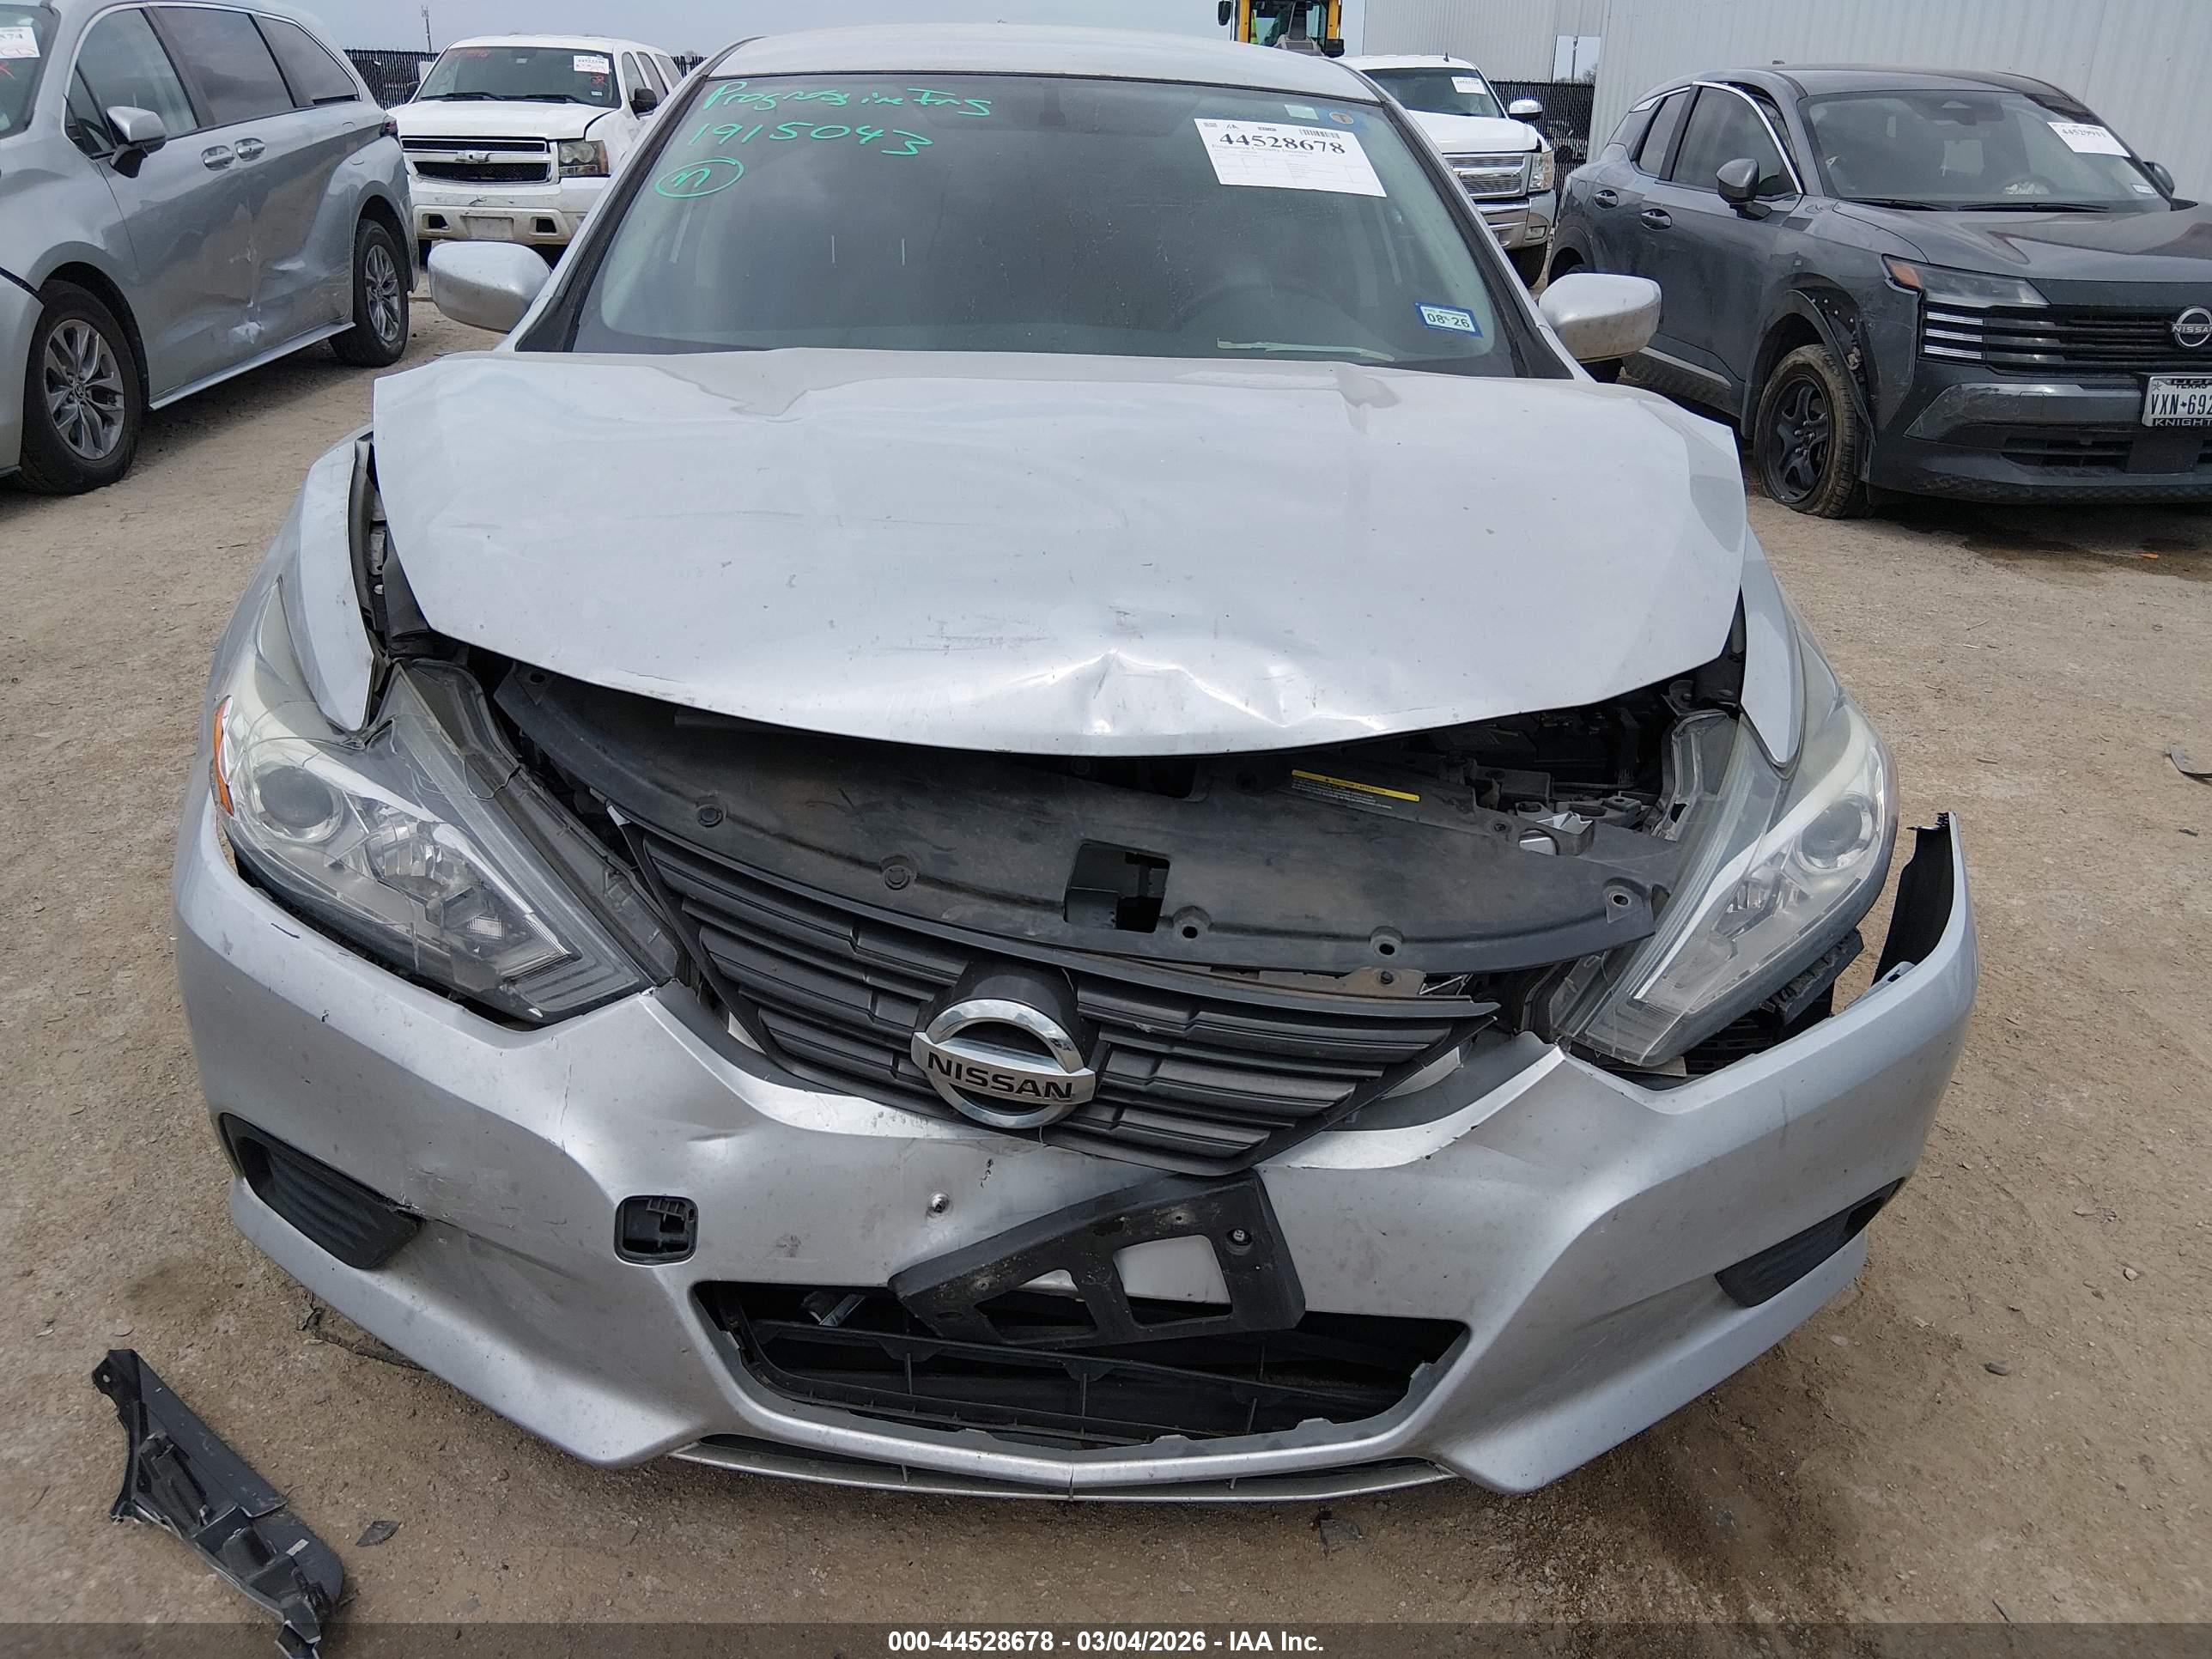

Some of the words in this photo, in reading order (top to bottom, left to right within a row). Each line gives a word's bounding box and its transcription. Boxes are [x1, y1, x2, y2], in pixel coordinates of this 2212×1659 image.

[687, 121, 934, 156] 1915043
[1219, 132, 1346, 155] 44528678
[927, 1051, 1073, 1099] NISSAN
